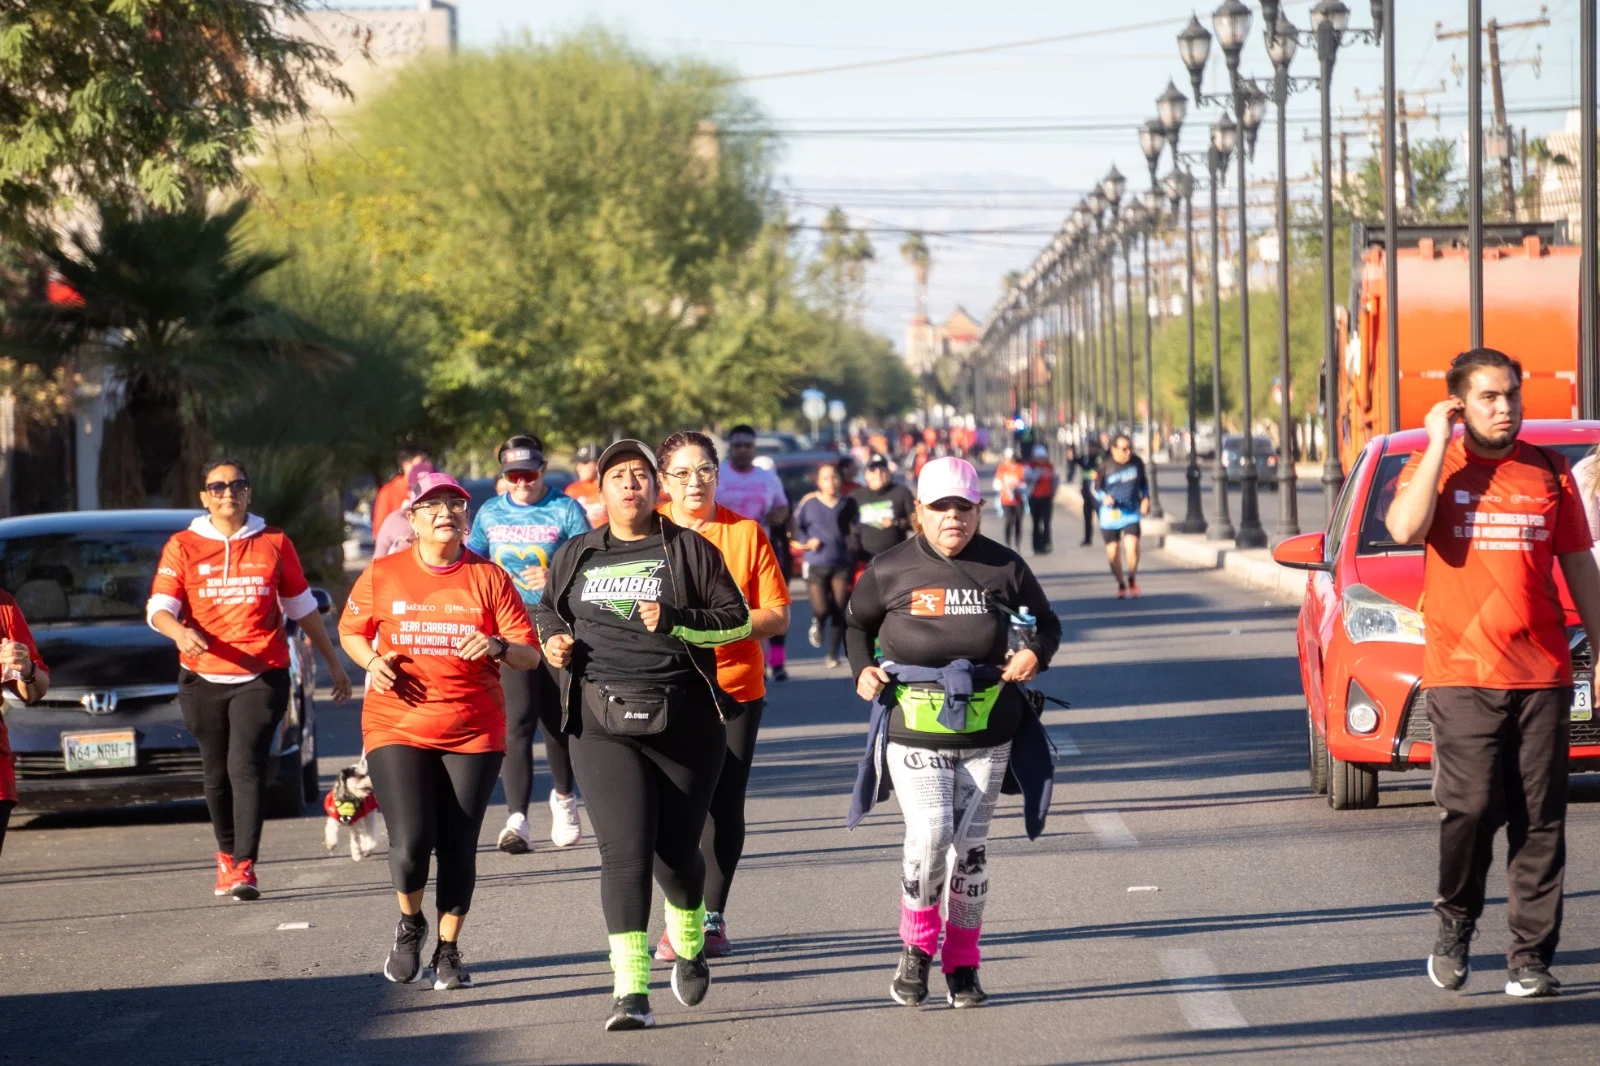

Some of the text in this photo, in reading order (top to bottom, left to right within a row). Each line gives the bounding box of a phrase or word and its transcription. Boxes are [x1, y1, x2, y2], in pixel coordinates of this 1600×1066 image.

[585, 577, 659, 593] RUMBA
[405, 603, 436, 612] MÉXICO
[944, 605, 989, 615] RUNNERS
[400, 621, 476, 636] 3ERA CARRERA POR
[391, 633, 399, 645] EL
[415, 634, 450, 647] MUNDIAL
